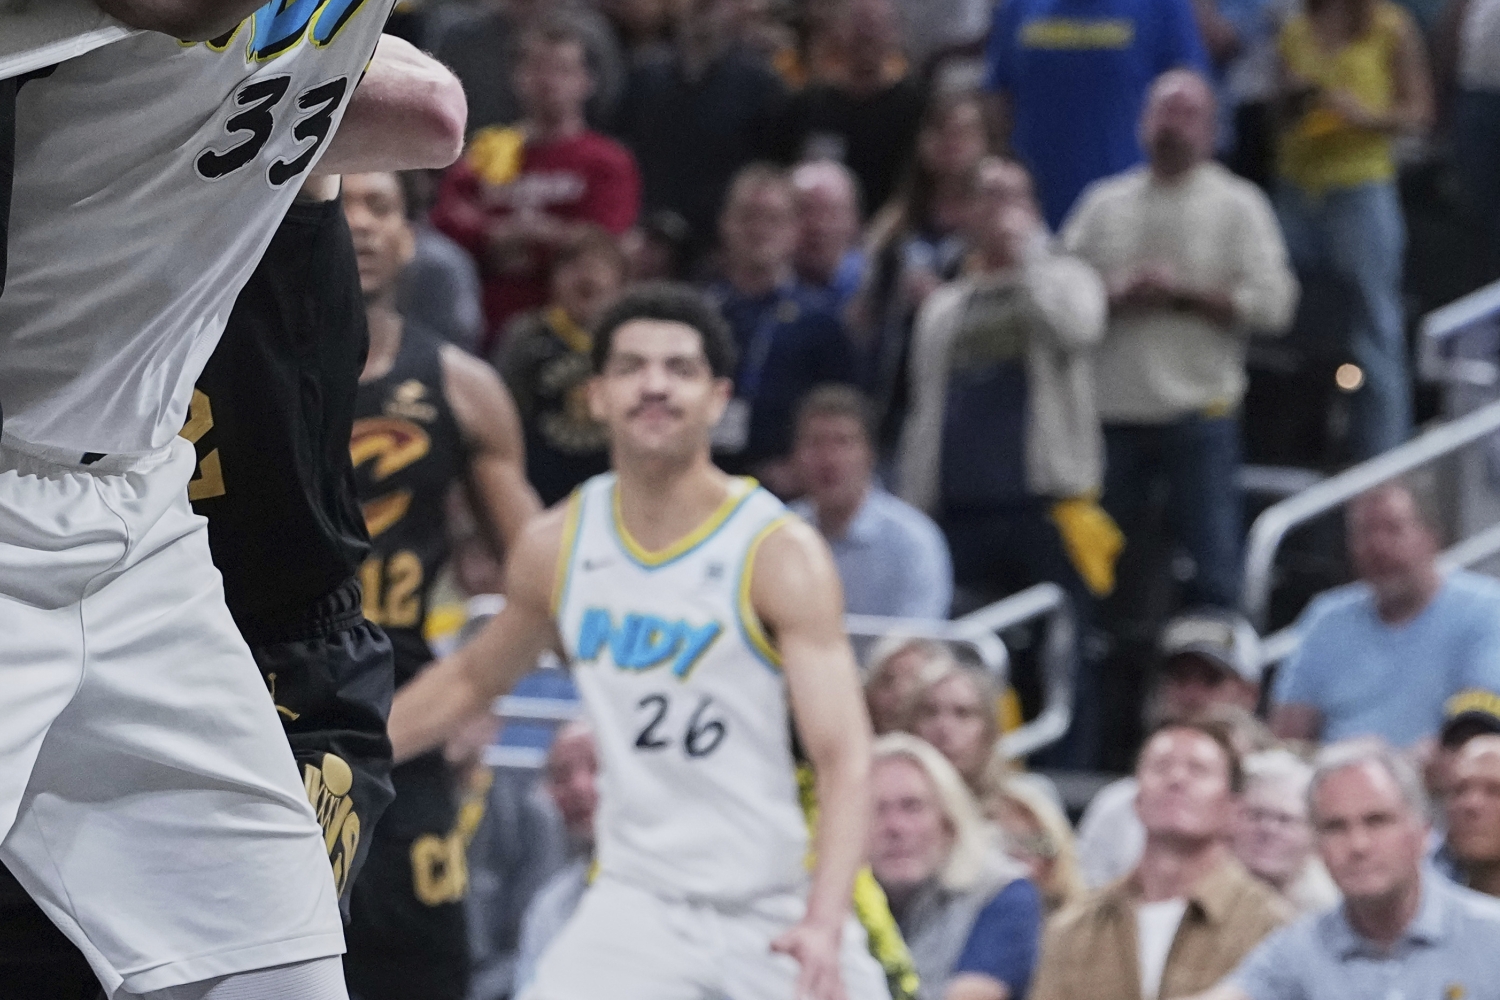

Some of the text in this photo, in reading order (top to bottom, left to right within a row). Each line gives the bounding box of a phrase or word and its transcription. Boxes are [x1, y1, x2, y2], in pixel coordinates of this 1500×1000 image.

[194, 74, 349, 188] 33
[359, 549, 425, 629] 12
[574, 608, 726, 684] INDY
[633, 694, 729, 759] 26
